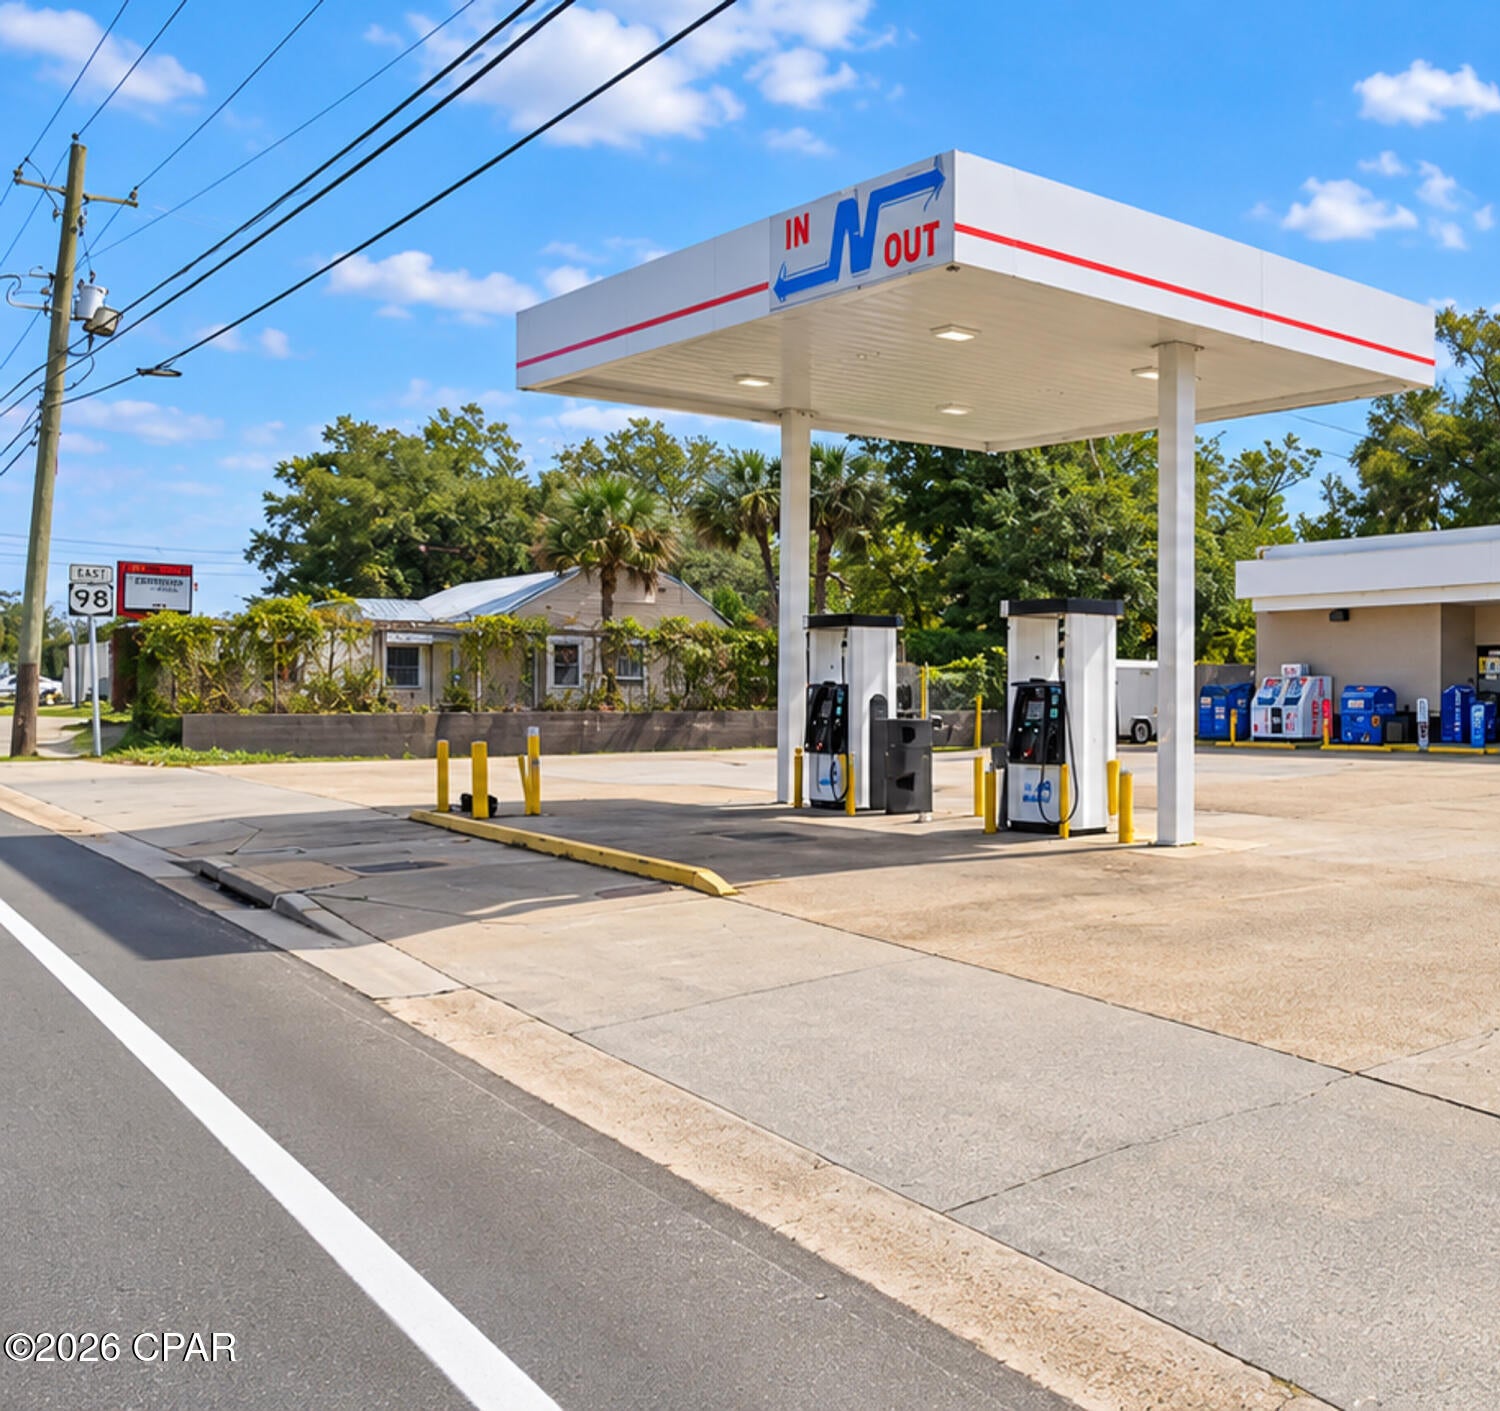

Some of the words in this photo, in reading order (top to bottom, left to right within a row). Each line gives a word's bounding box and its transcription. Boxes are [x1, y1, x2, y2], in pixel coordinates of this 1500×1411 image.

[785, 212, 810, 250] IN
[884, 220, 941, 268] OUT
[77, 568, 106, 580] EAST
[75, 589, 108, 608] 98
